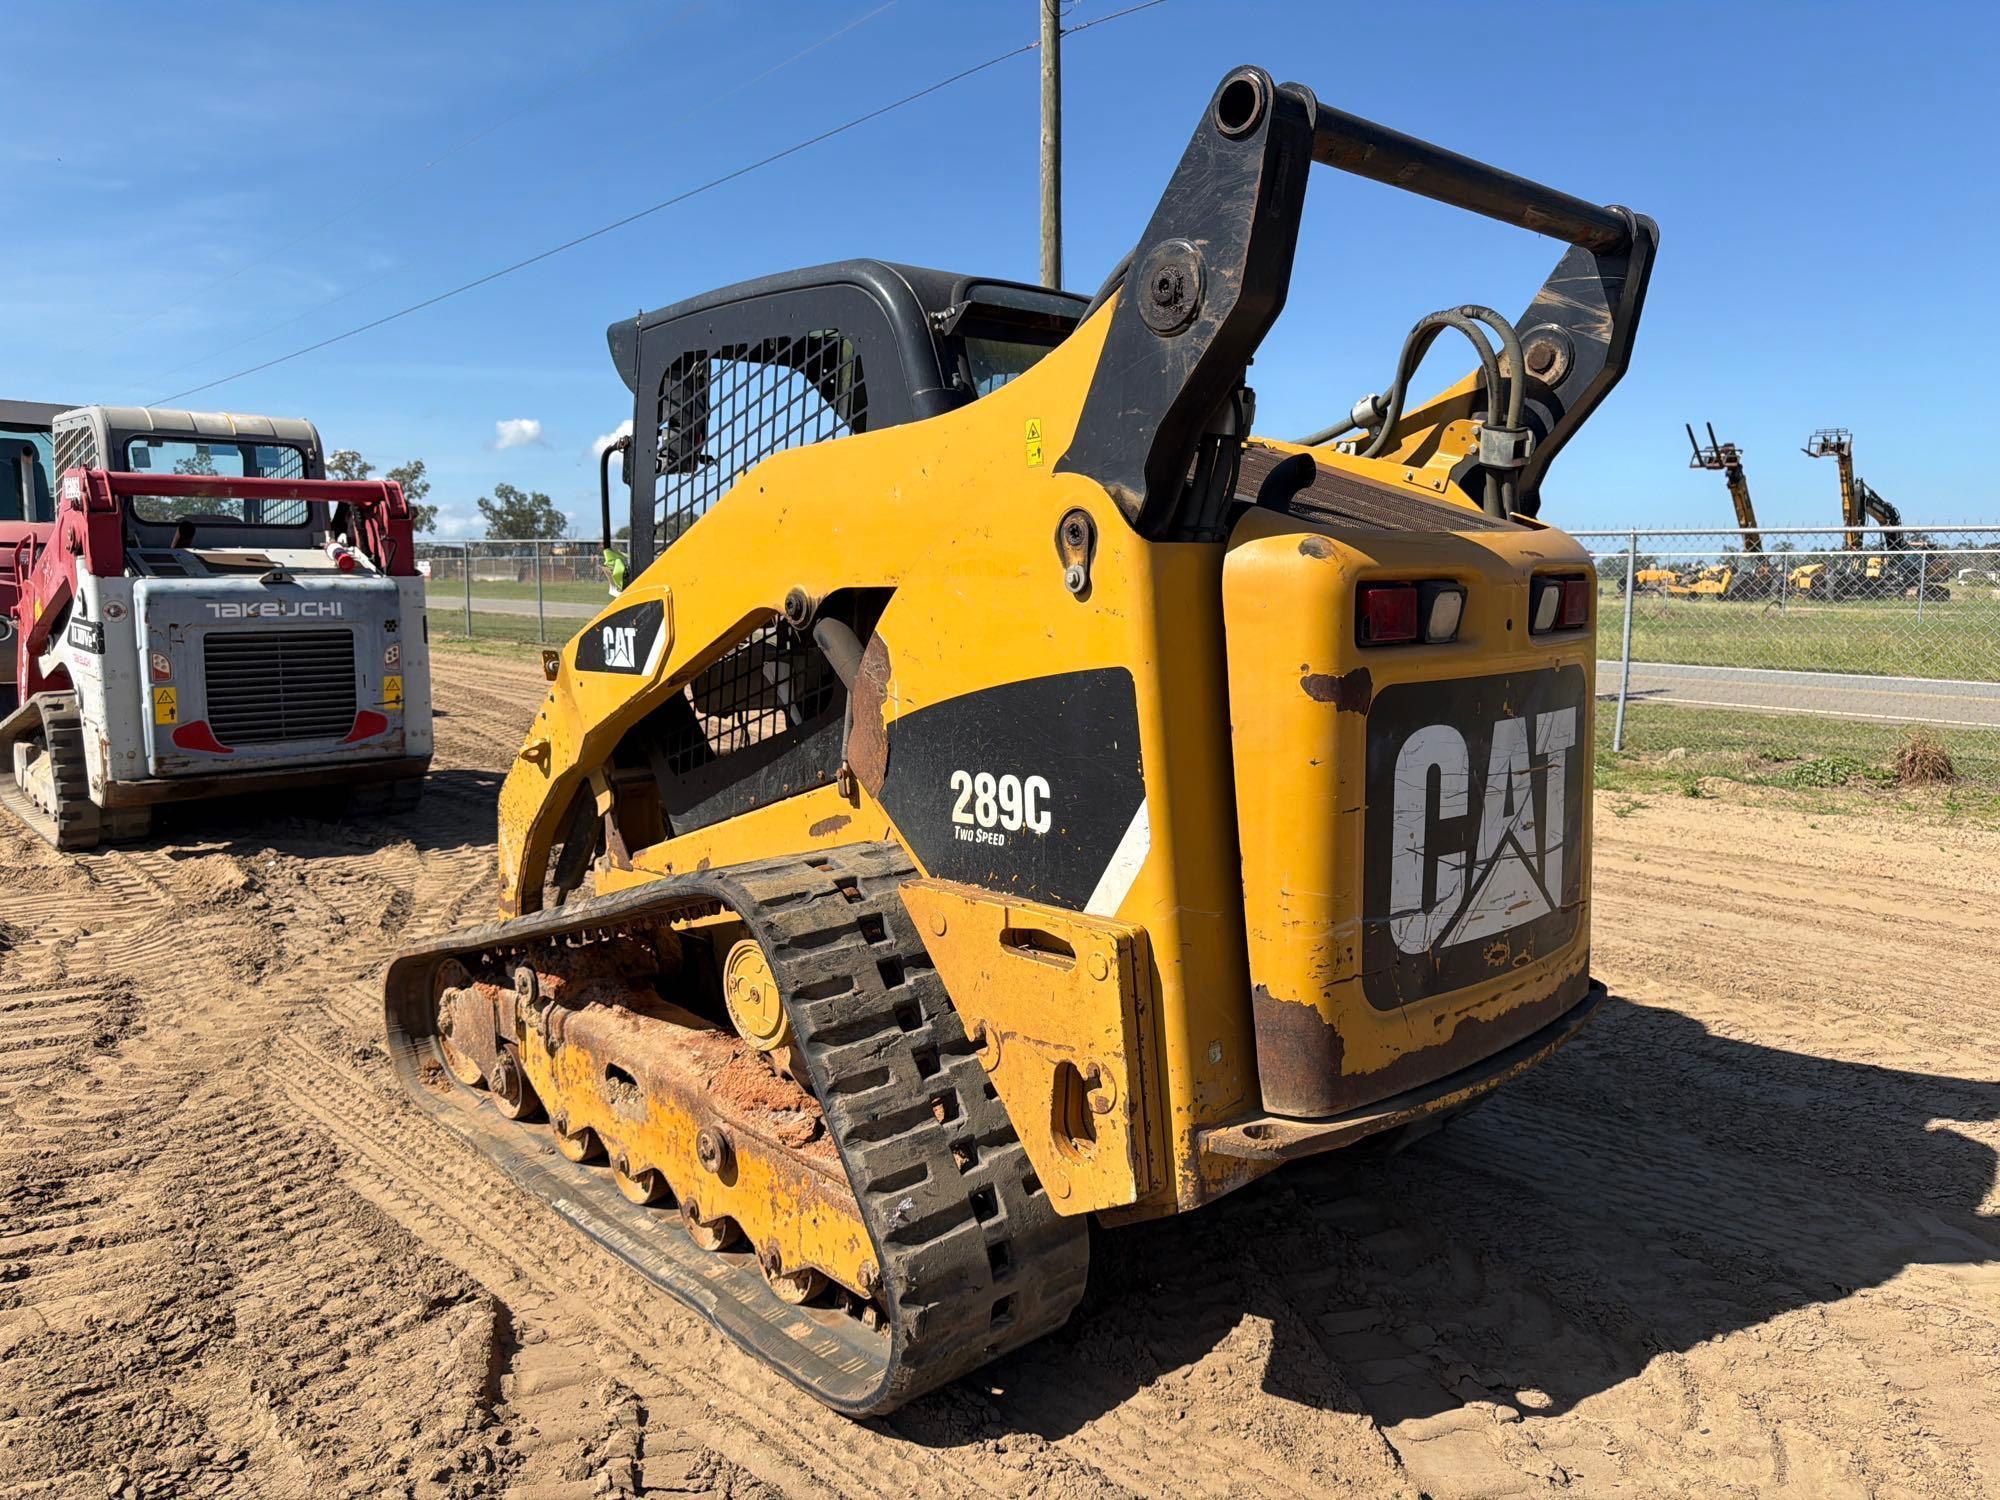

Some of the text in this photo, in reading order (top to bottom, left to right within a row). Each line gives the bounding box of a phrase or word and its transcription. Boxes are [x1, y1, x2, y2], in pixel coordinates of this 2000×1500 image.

[602, 625, 637, 668] CAT
[950, 769, 1052, 834] 289C
[1390, 706, 1577, 955] CAT
